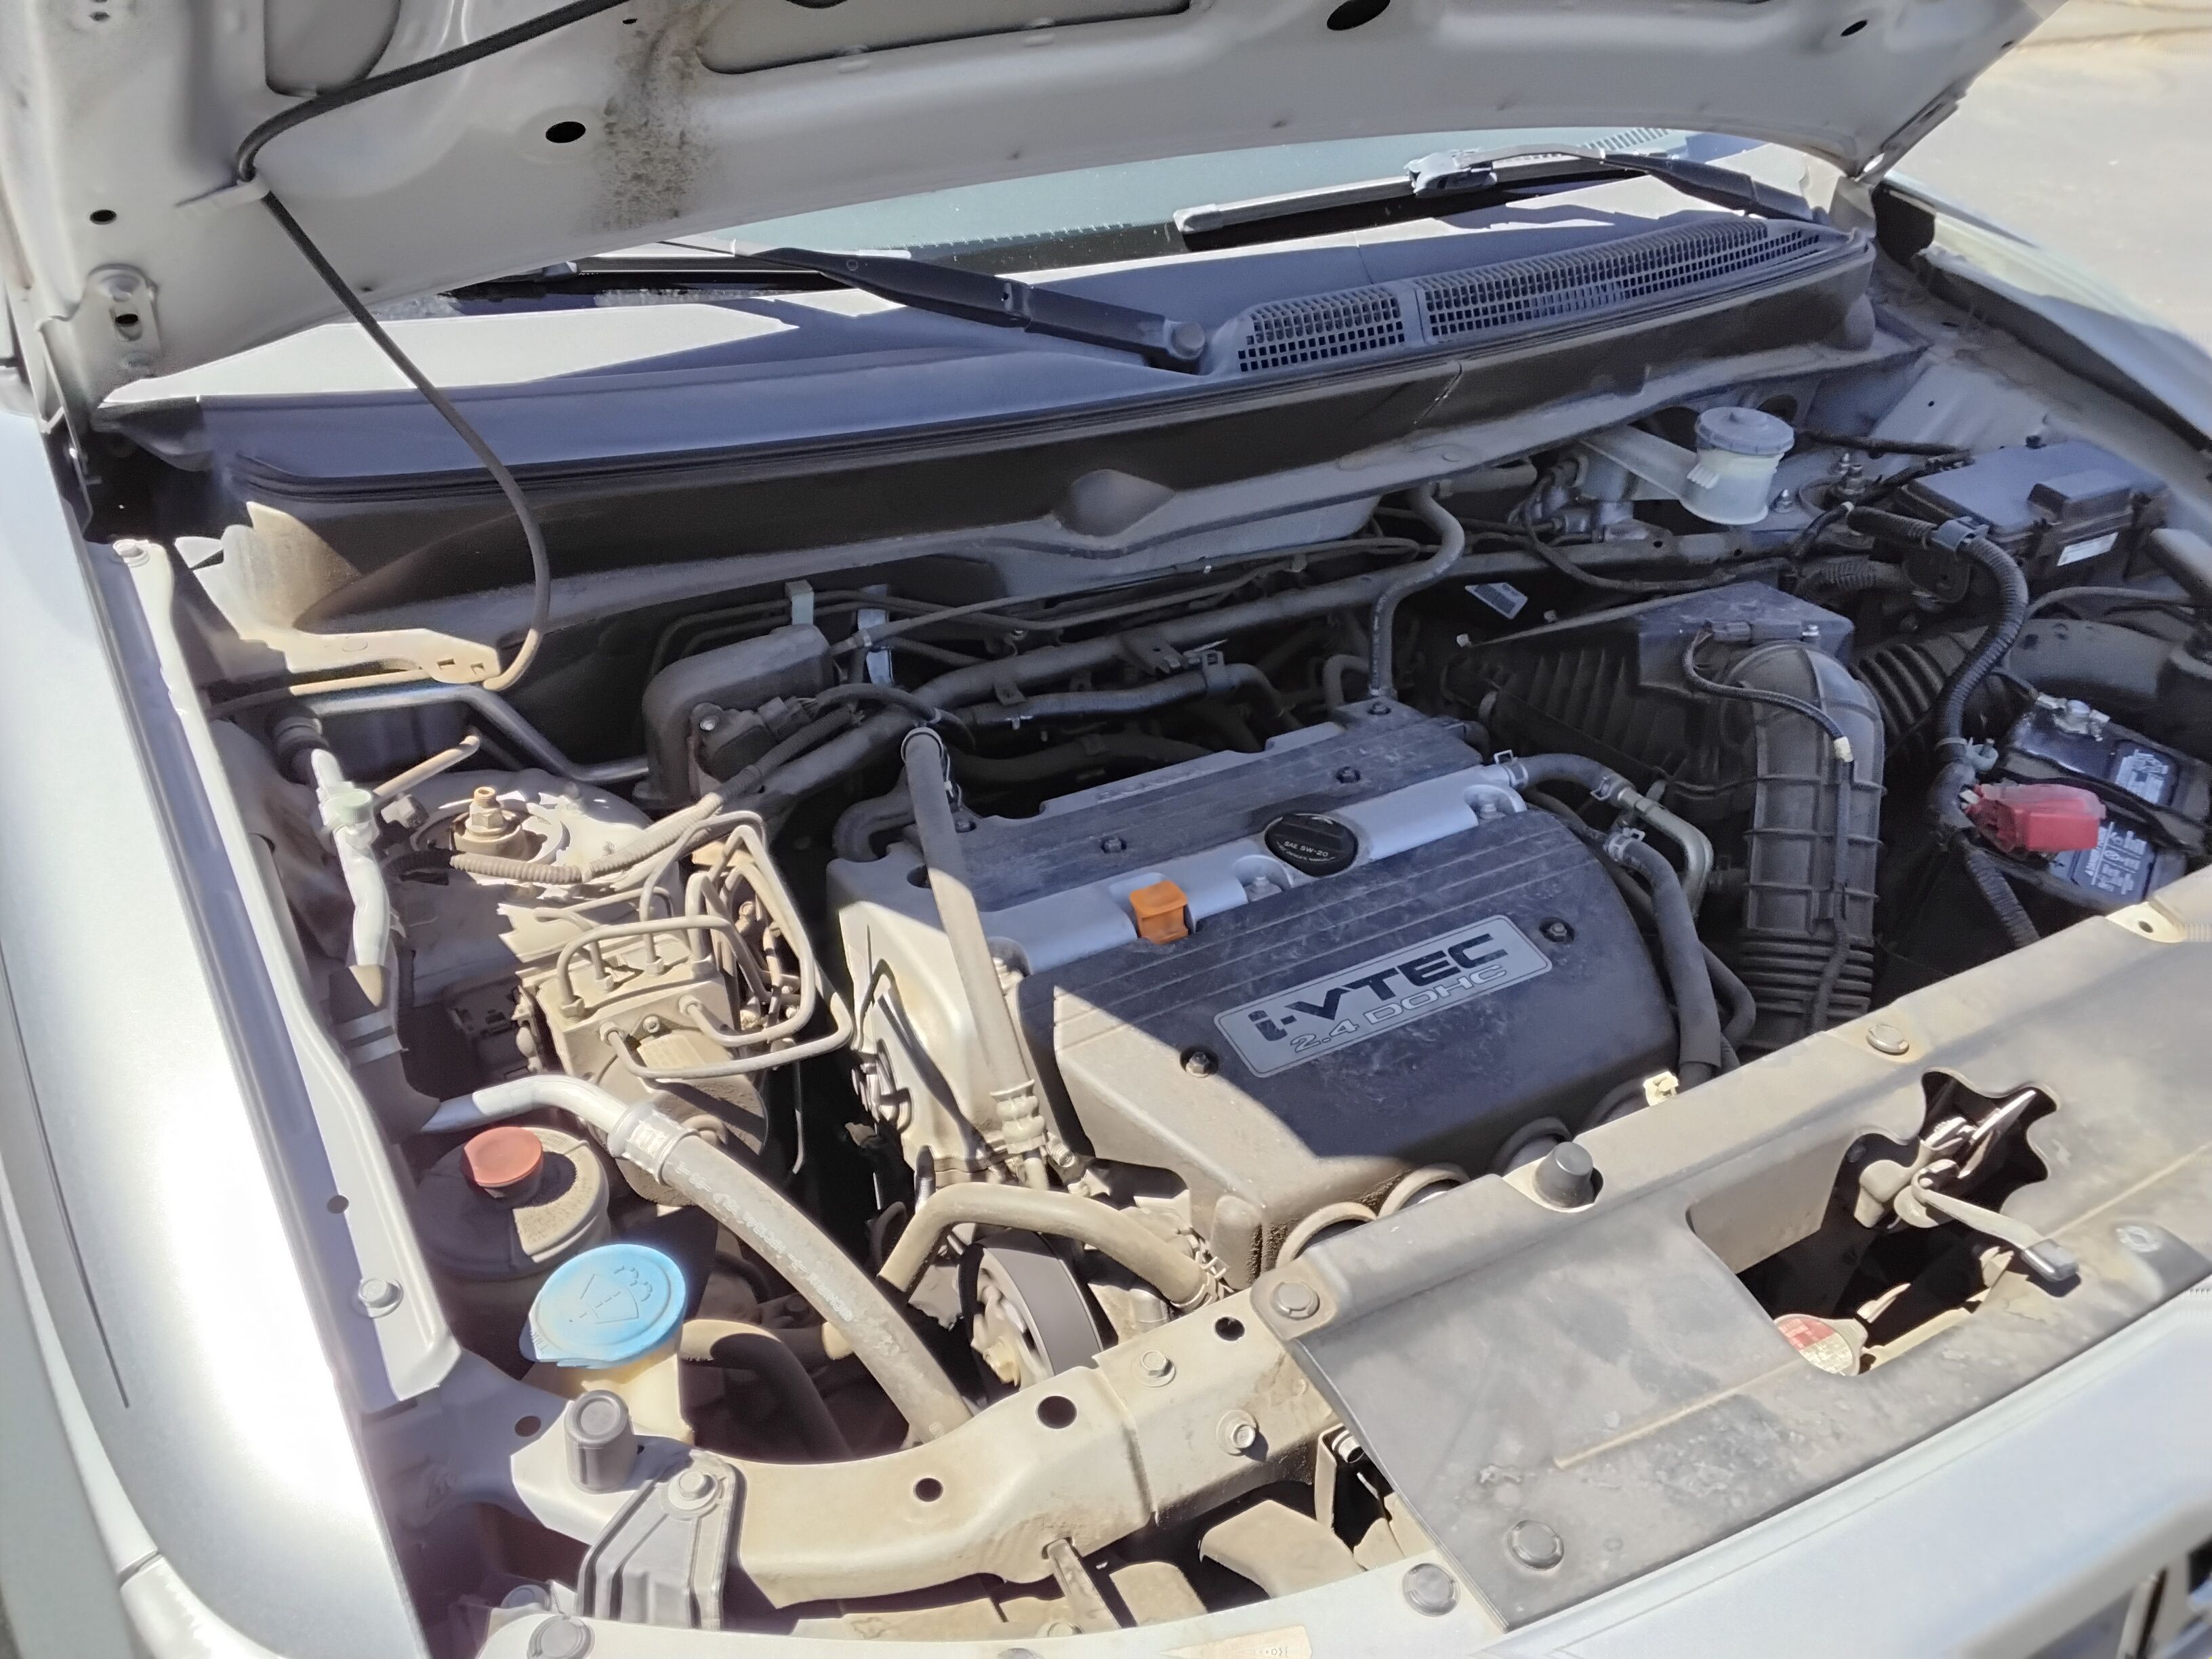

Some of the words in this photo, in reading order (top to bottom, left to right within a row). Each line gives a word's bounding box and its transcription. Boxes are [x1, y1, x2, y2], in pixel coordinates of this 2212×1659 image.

[1284, 841, 1298, 849] SAE
[1248, 933, 1509, 1042] i-VTEC
[1290, 1019, 1359, 1053] 2.4
[1364, 964, 1508, 1025] DOHC
